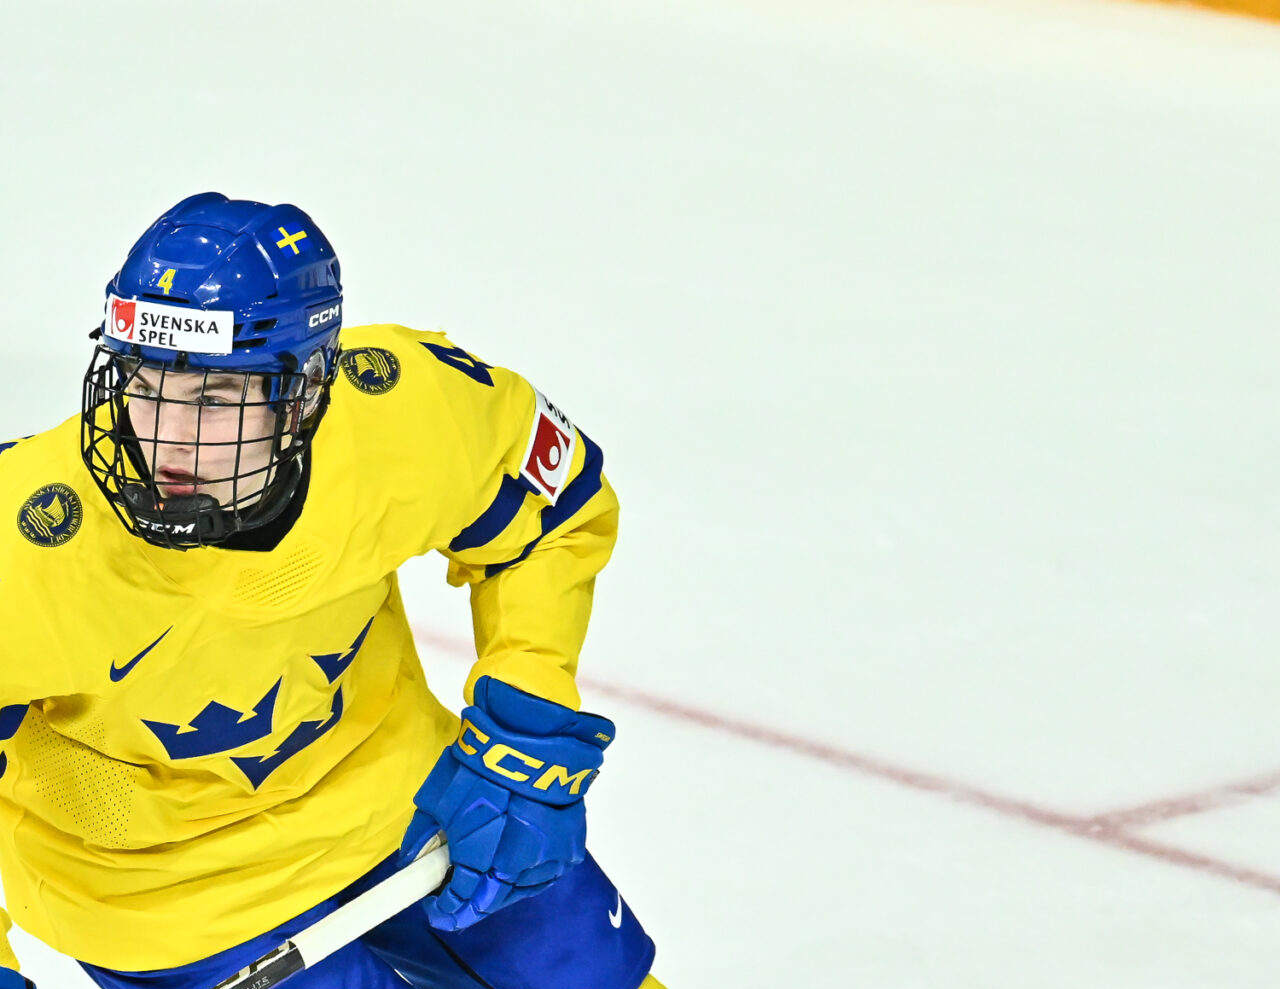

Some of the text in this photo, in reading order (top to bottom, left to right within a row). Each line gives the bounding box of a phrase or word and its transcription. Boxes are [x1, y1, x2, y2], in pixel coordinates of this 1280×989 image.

[157, 268, 177, 295] 4
[140, 312, 219, 335] SVENSKA
[308, 304, 340, 328] CCM
[138, 328, 178, 348] SPEL
[458, 718, 594, 795] CCM
